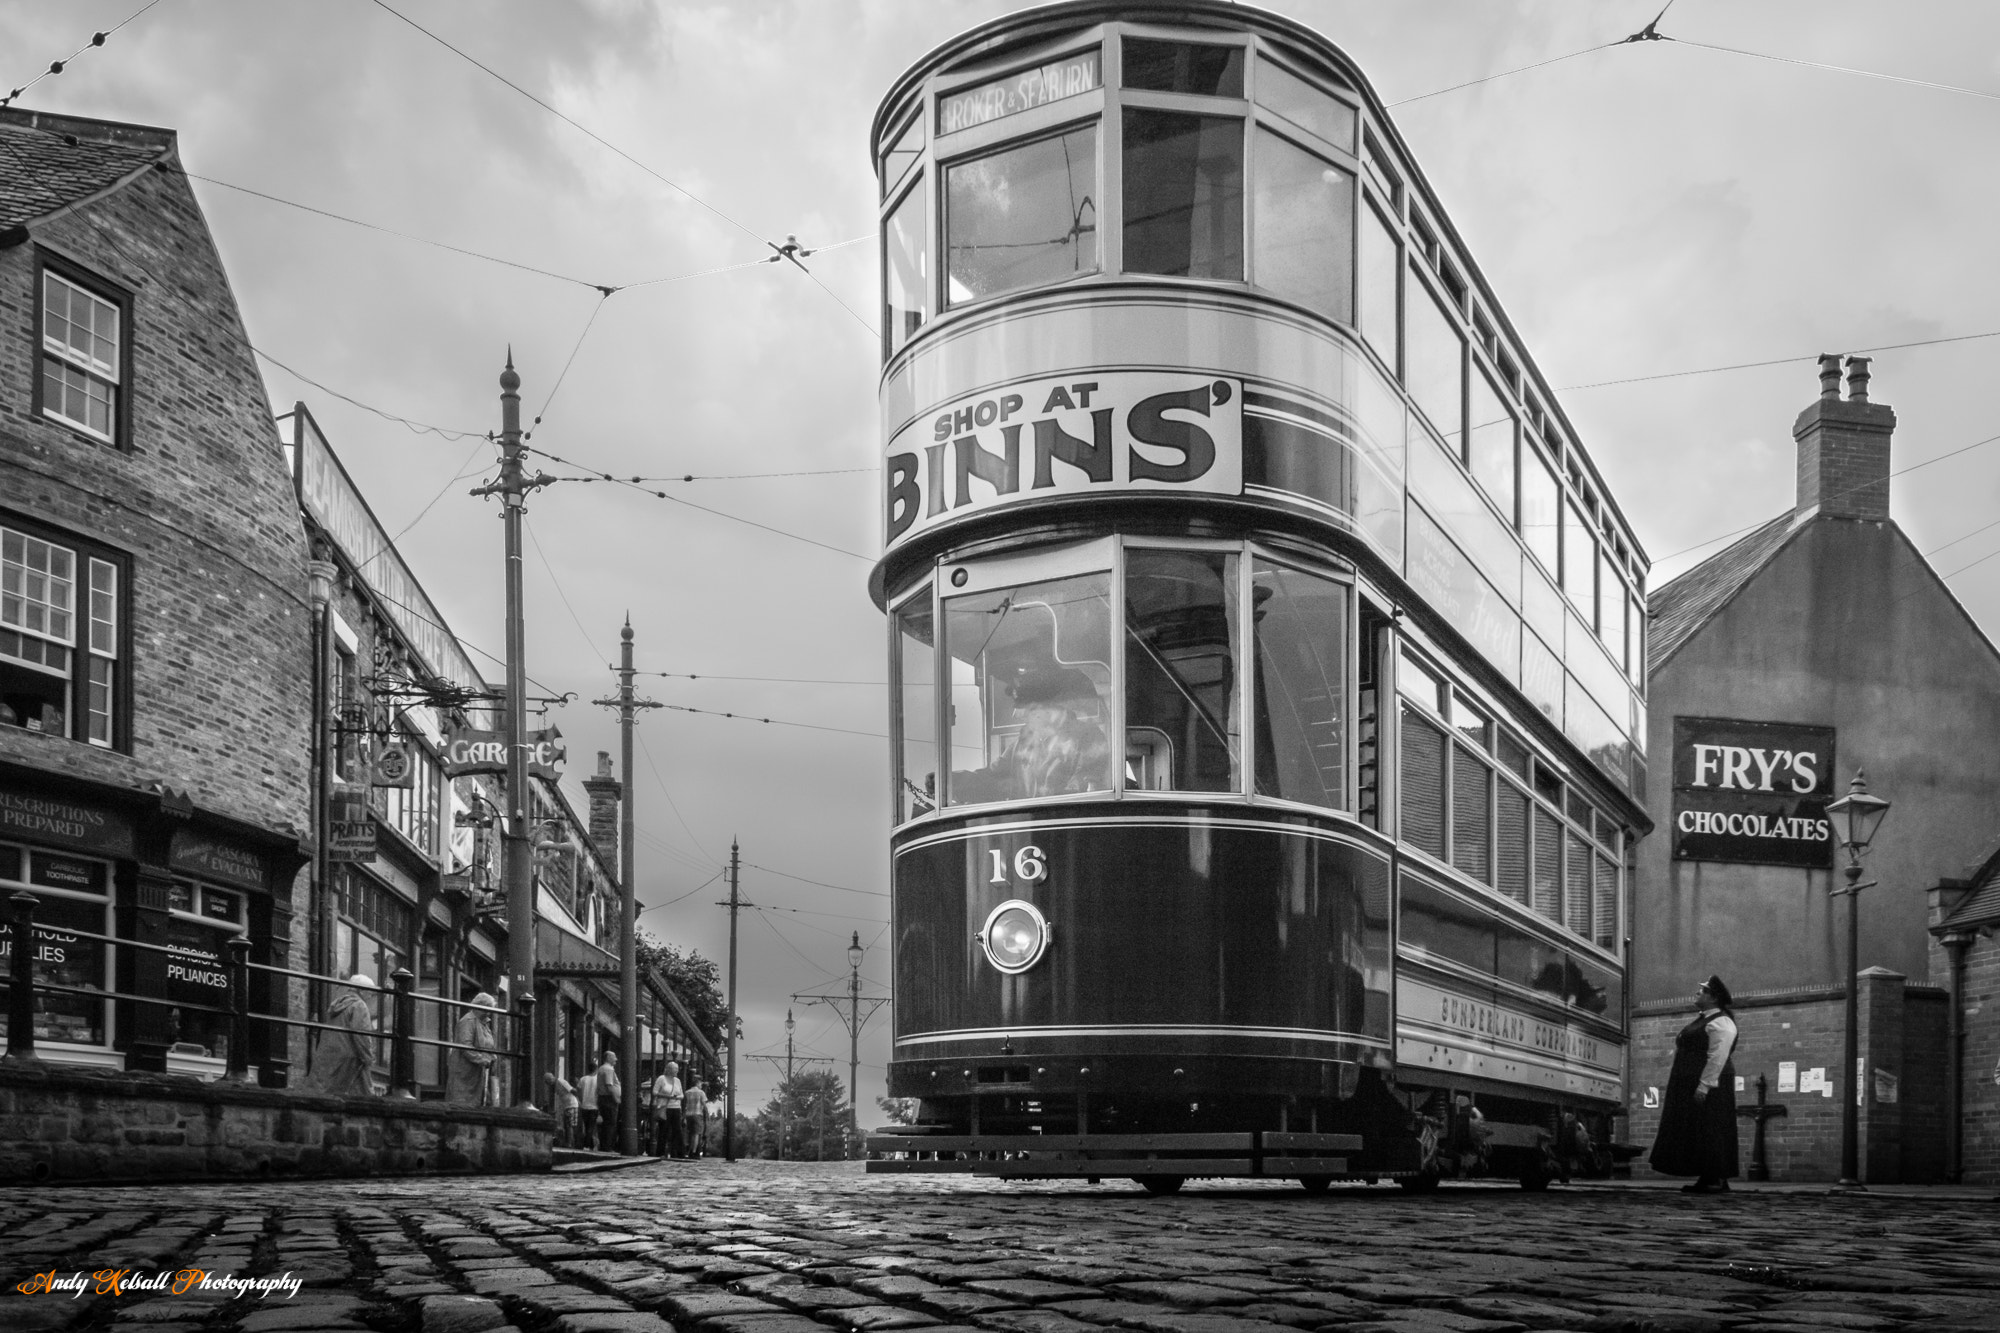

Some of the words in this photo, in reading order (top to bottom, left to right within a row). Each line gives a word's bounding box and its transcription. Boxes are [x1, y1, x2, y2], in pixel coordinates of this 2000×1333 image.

[952, 87, 1006, 132] ROKER
[1007, 91, 1015, 108] &
[1016, 60, 1094, 111] SEABURN
[934, 393, 1024, 441] SHOP
[1041, 381, 1099, 414] AT
[1692, 743, 1817, 794] FRY'S
[4, 808, 85, 838] PREPARED
[1678, 810, 1829, 841] CHOCOLATES
[46, 870, 89, 885] TOOTHPASTE
[988, 845, 1048, 885] 16
[1441, 997, 1525, 1042] SUNDERLAND
